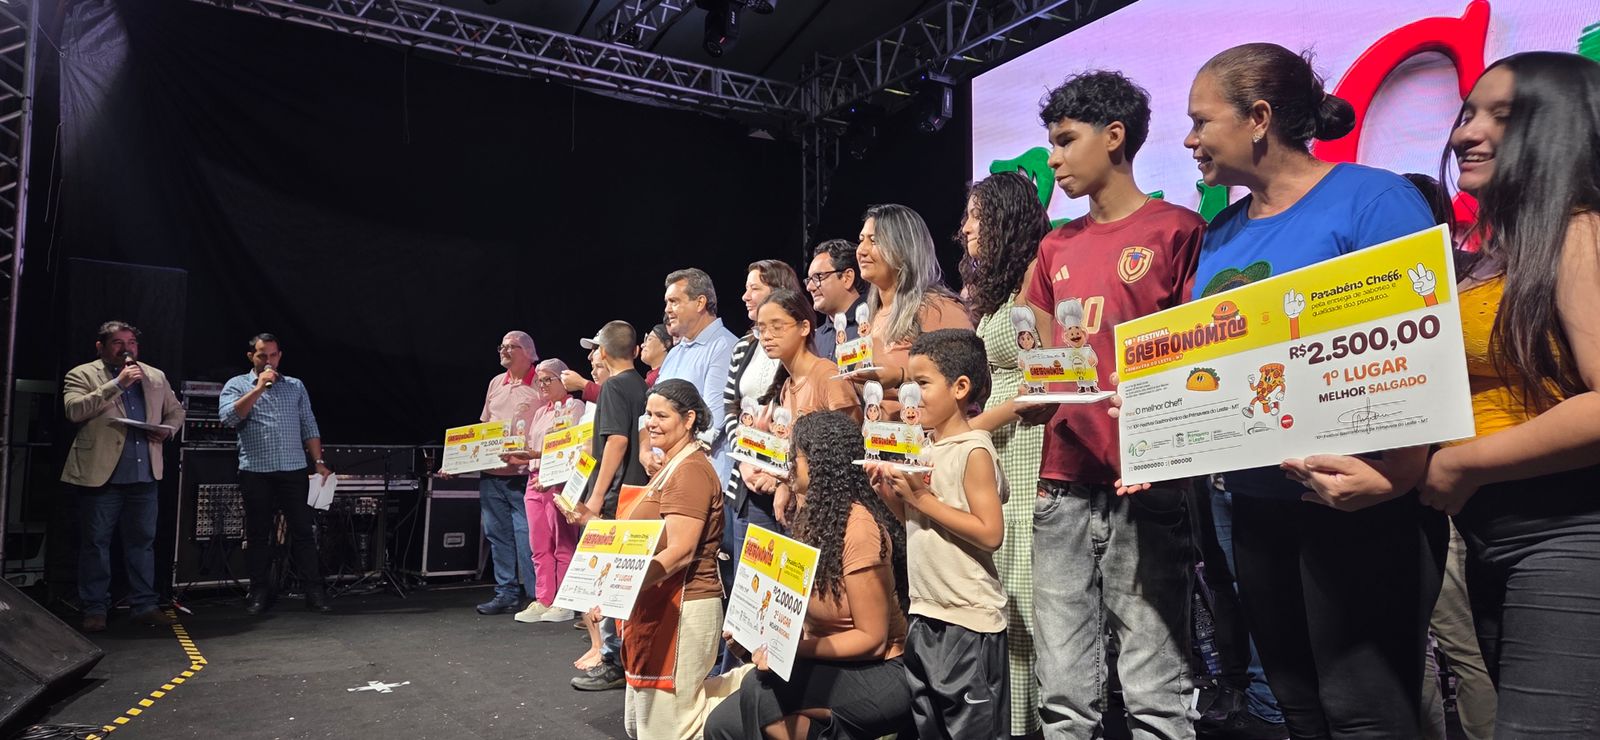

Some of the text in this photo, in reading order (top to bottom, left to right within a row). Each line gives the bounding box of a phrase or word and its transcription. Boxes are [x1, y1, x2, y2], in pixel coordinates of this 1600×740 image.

[1311, 280, 1363, 301] Parabéns
[1311, 300, 1326, 310] pela
[1327, 294, 1351, 306] entrega
[1352, 290, 1361, 298] de
[1312, 304, 1342, 317] qualidade
[1344, 300, 1356, 309] dos
[1125, 316, 1247, 365] GASTRONÔMICO
[1137, 328, 1169, 343] FESTIVAL
[1289, 315, 1441, 365] R$2.500,00
[1322, 356, 1408, 386] 1º LUGAR
[1318, 374, 1427, 403] MELHOR SALGADO
[1141, 402, 1163, 413] melhor
[1164, 397, 1182, 408] Cheff
[1188, 409, 1209, 418] Primavera
[1216, 405, 1228, 413] Leste
